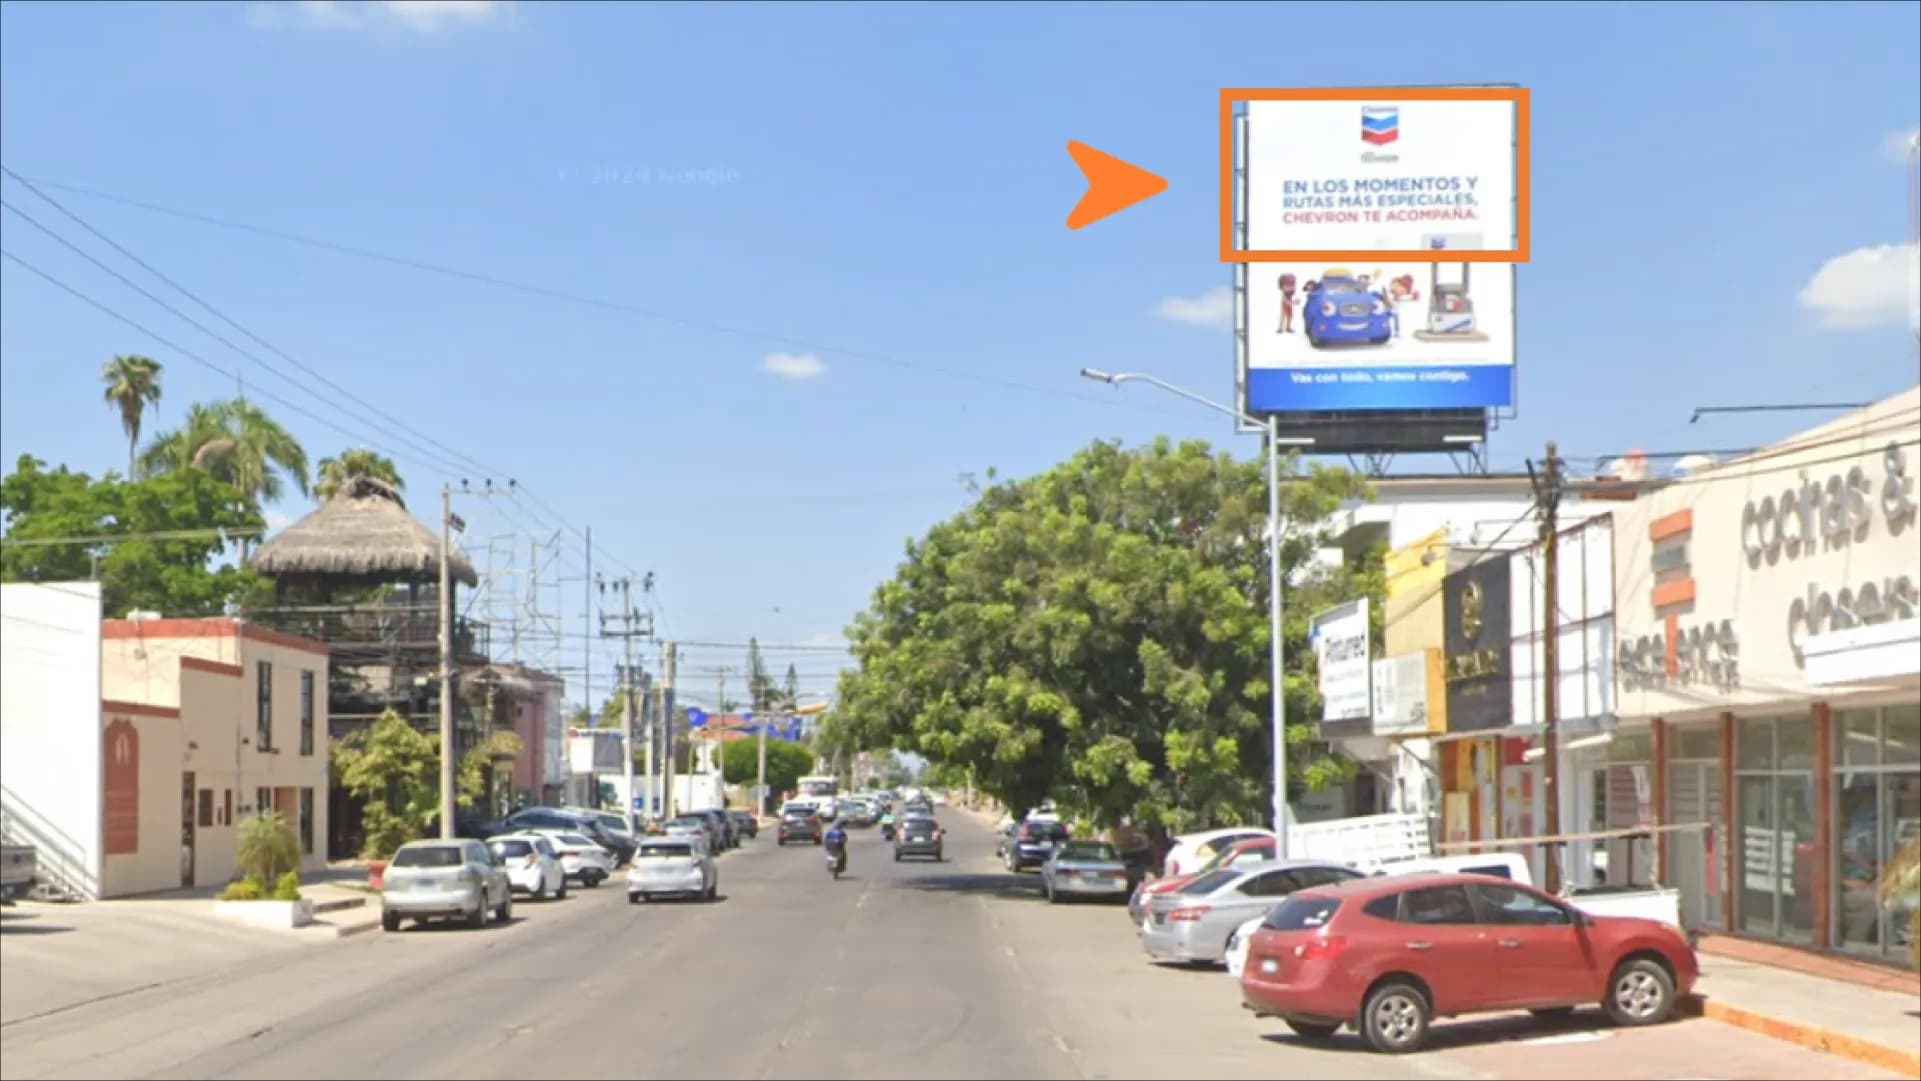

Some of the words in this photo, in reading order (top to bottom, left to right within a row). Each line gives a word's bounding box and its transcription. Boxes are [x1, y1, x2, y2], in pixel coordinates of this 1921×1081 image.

[1283, 180, 1308, 194] EN
[1313, 179, 1349, 194] LOS
[1354, 177, 1461, 193] MOMENTOS
[1466, 176, 1479, 191] Y
[1283, 196, 1335, 208] RUTAS
[1339, 193, 1373, 208] MÁS
[1377, 193, 1479, 207] ESPECIALES,
[1282, 210, 1359, 225] CHEVRON
[1363, 209, 1382, 223] TE
[1386, 206, 1479, 223] ACOMPAÑA.
